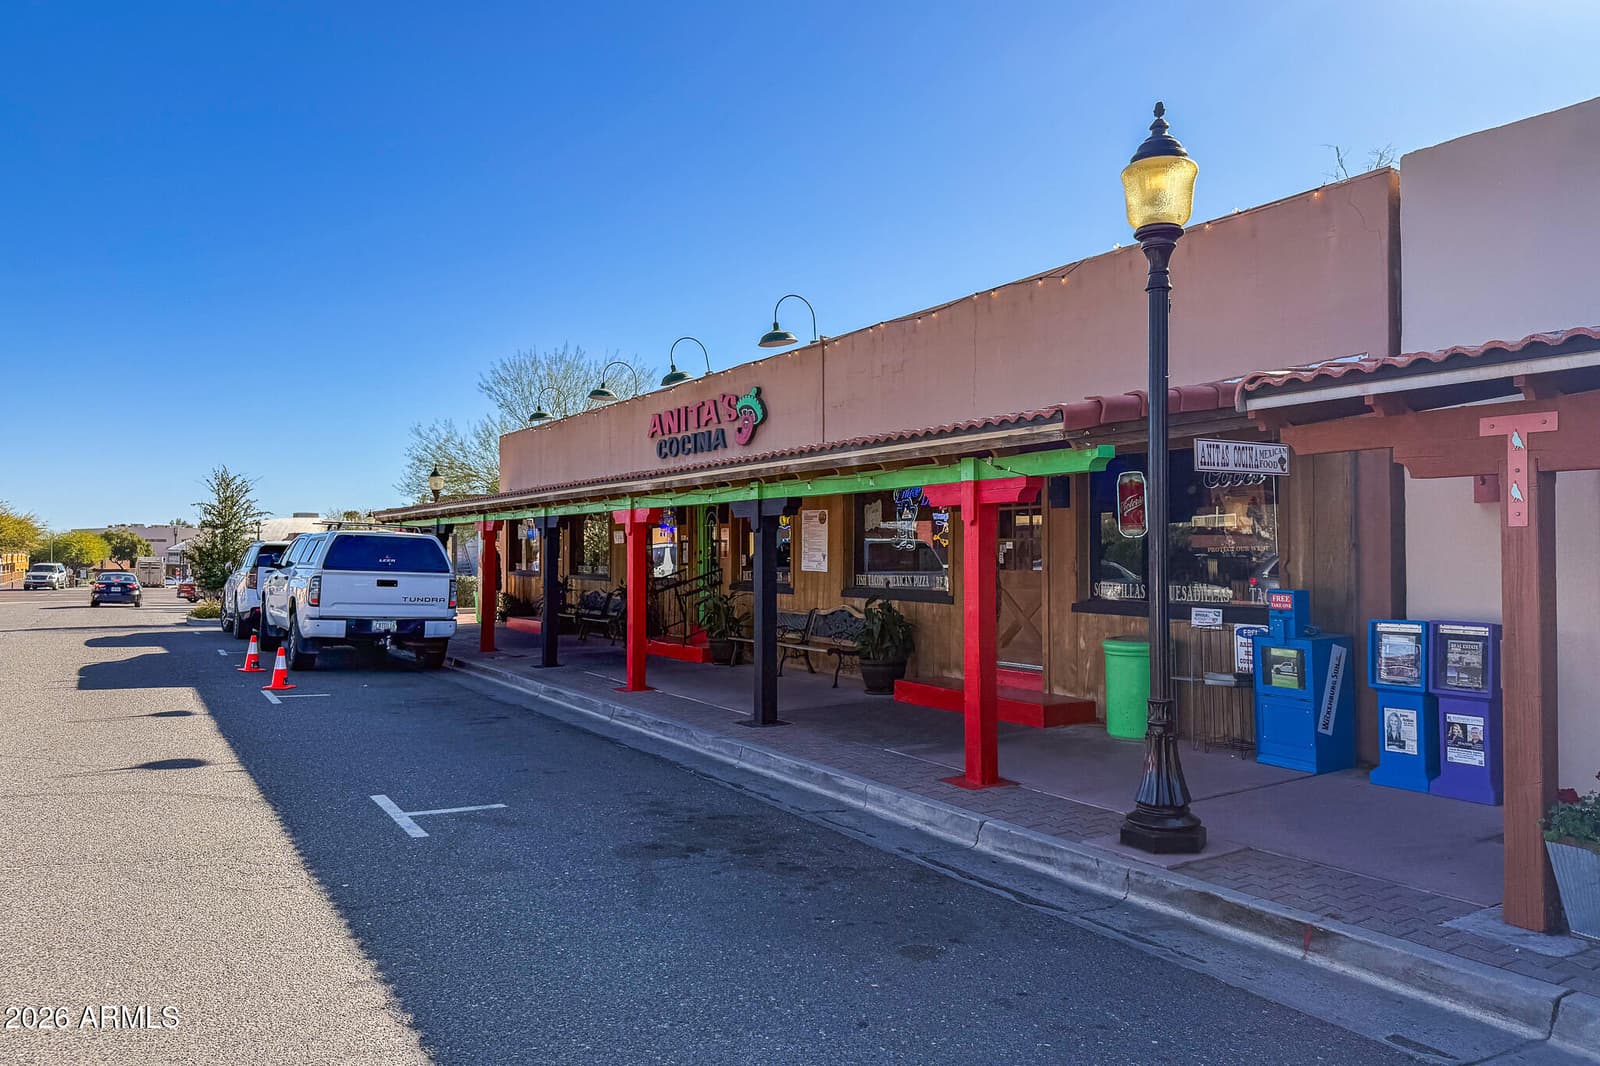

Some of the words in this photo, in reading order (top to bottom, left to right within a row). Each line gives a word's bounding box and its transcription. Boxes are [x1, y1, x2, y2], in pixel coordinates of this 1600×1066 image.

[648, 394, 739, 438] ANITA'S
[656, 428, 728, 459] COCINA
[1199, 443, 1230, 468] ANITAS
[1233, 446, 1259, 469] COCINA
[1259, 447, 1287, 460] MEXICAN
[1259, 459, 1278, 470] FOOD
[1272, 594, 1291, 603] FREE
